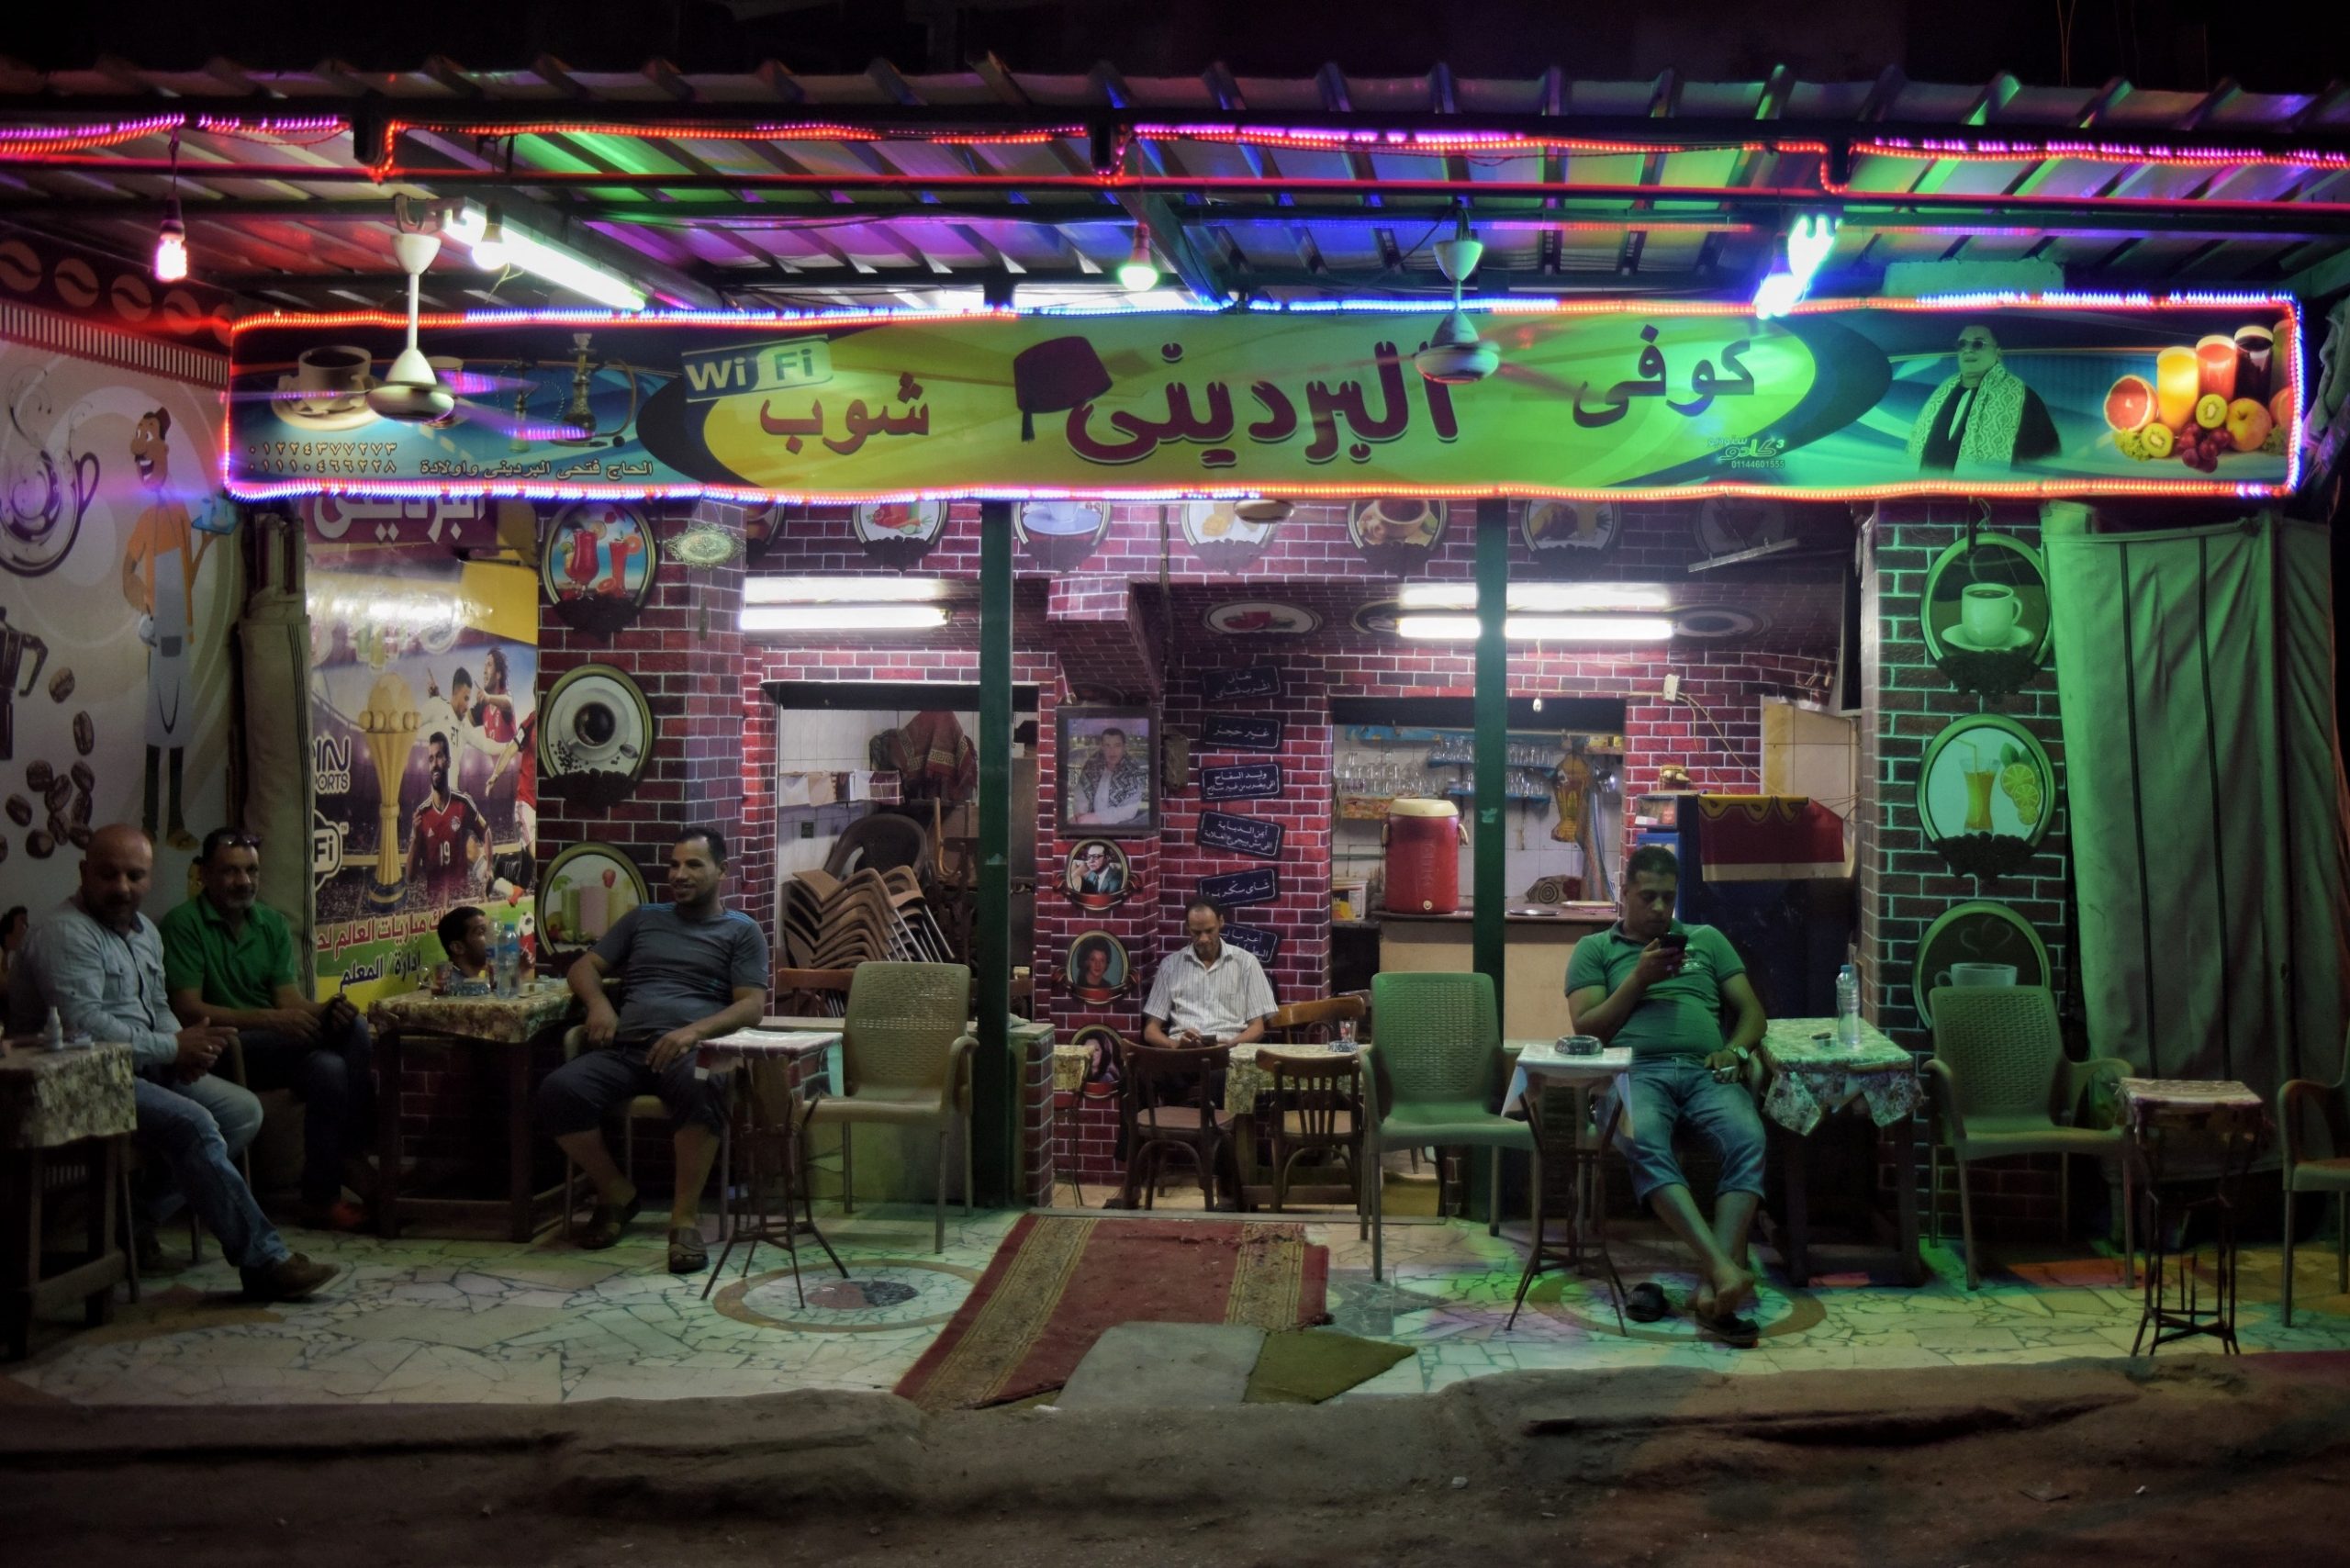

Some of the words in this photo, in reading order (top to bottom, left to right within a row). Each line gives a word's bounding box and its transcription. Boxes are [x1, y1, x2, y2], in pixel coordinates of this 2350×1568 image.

[1572, 323, 1755, 429] كوفى
[759, 371, 930, 455] شوب
[555, 458, 601, 481] فتحى
[604, 460, 654, 481] الحاج
[334, 918, 375, 961] العالم
[377, 913, 426, 944] مباريات
[340, 956, 384, 993] المعلم
